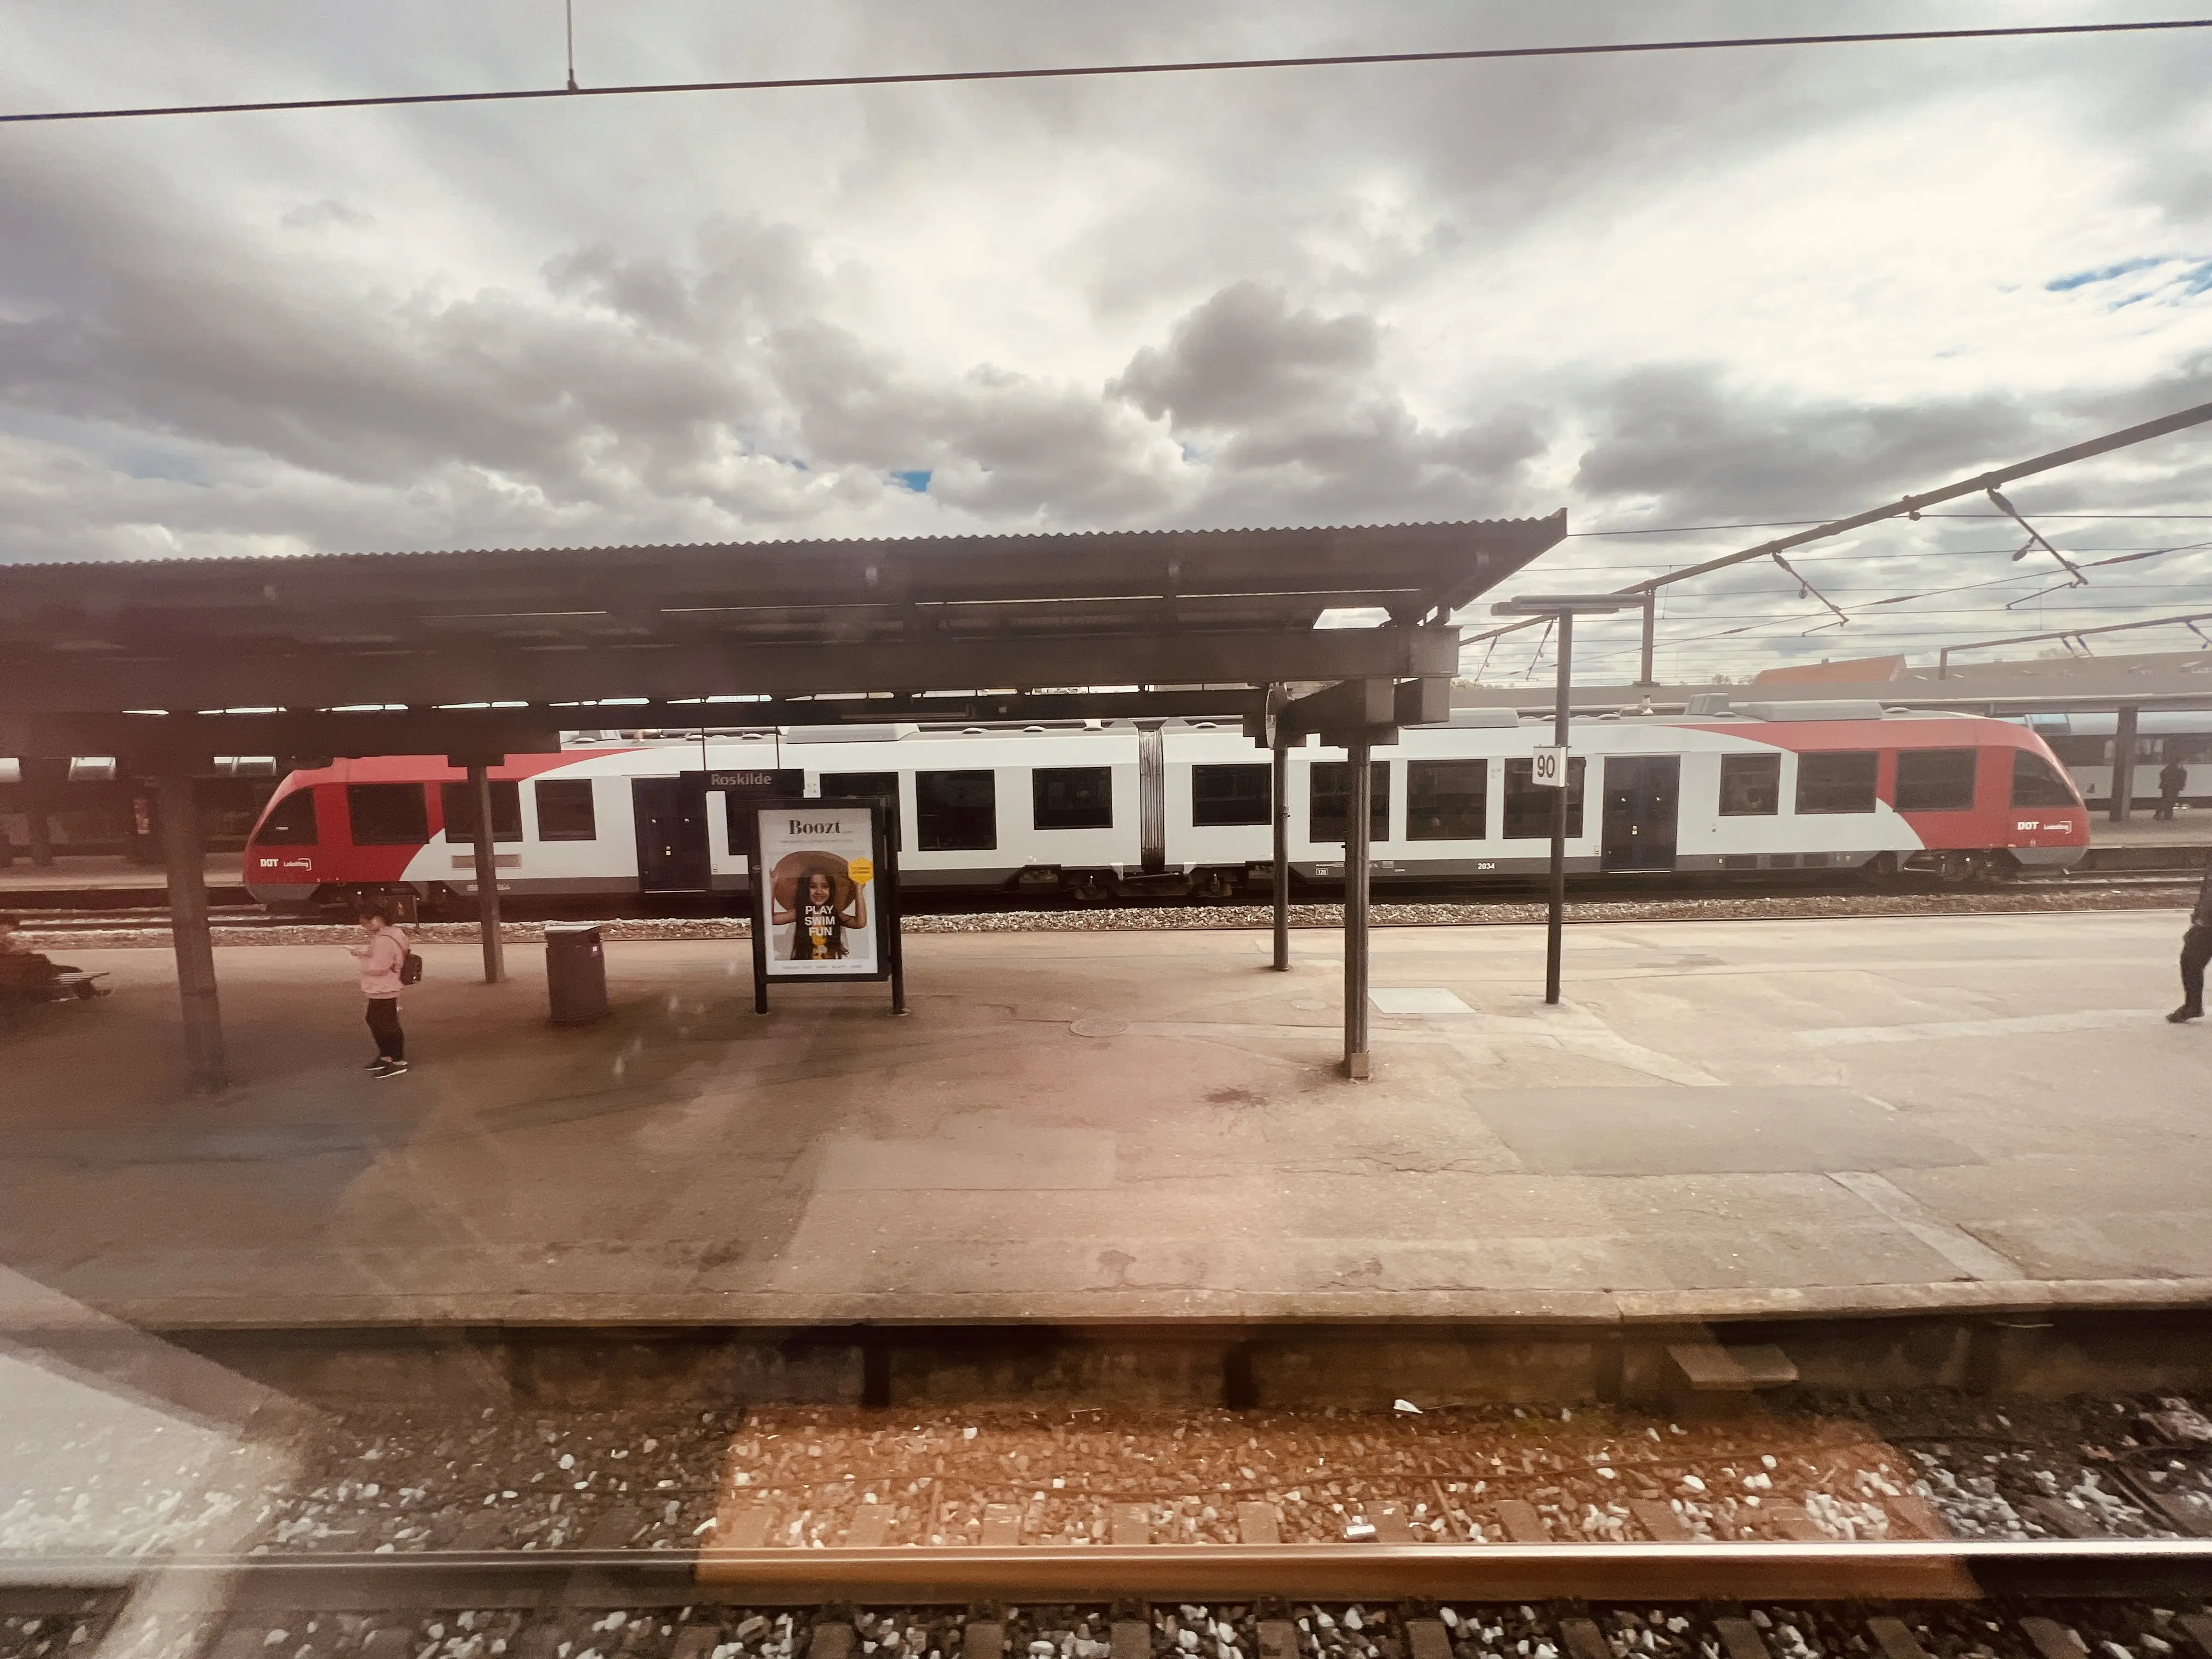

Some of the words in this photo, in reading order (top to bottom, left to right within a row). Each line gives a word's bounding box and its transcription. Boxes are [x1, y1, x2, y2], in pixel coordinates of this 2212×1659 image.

[1537, 754, 1555, 778] 90
[711, 772, 772, 785] Roskilde
[789, 820, 840, 834] Boozt
[2017, 821, 2040, 831] DOT
[260, 859, 279, 867] DOT
[805, 905, 833, 915] PLAY
[804, 916, 836, 926] SWIM
[809, 927, 832, 936] FUN
